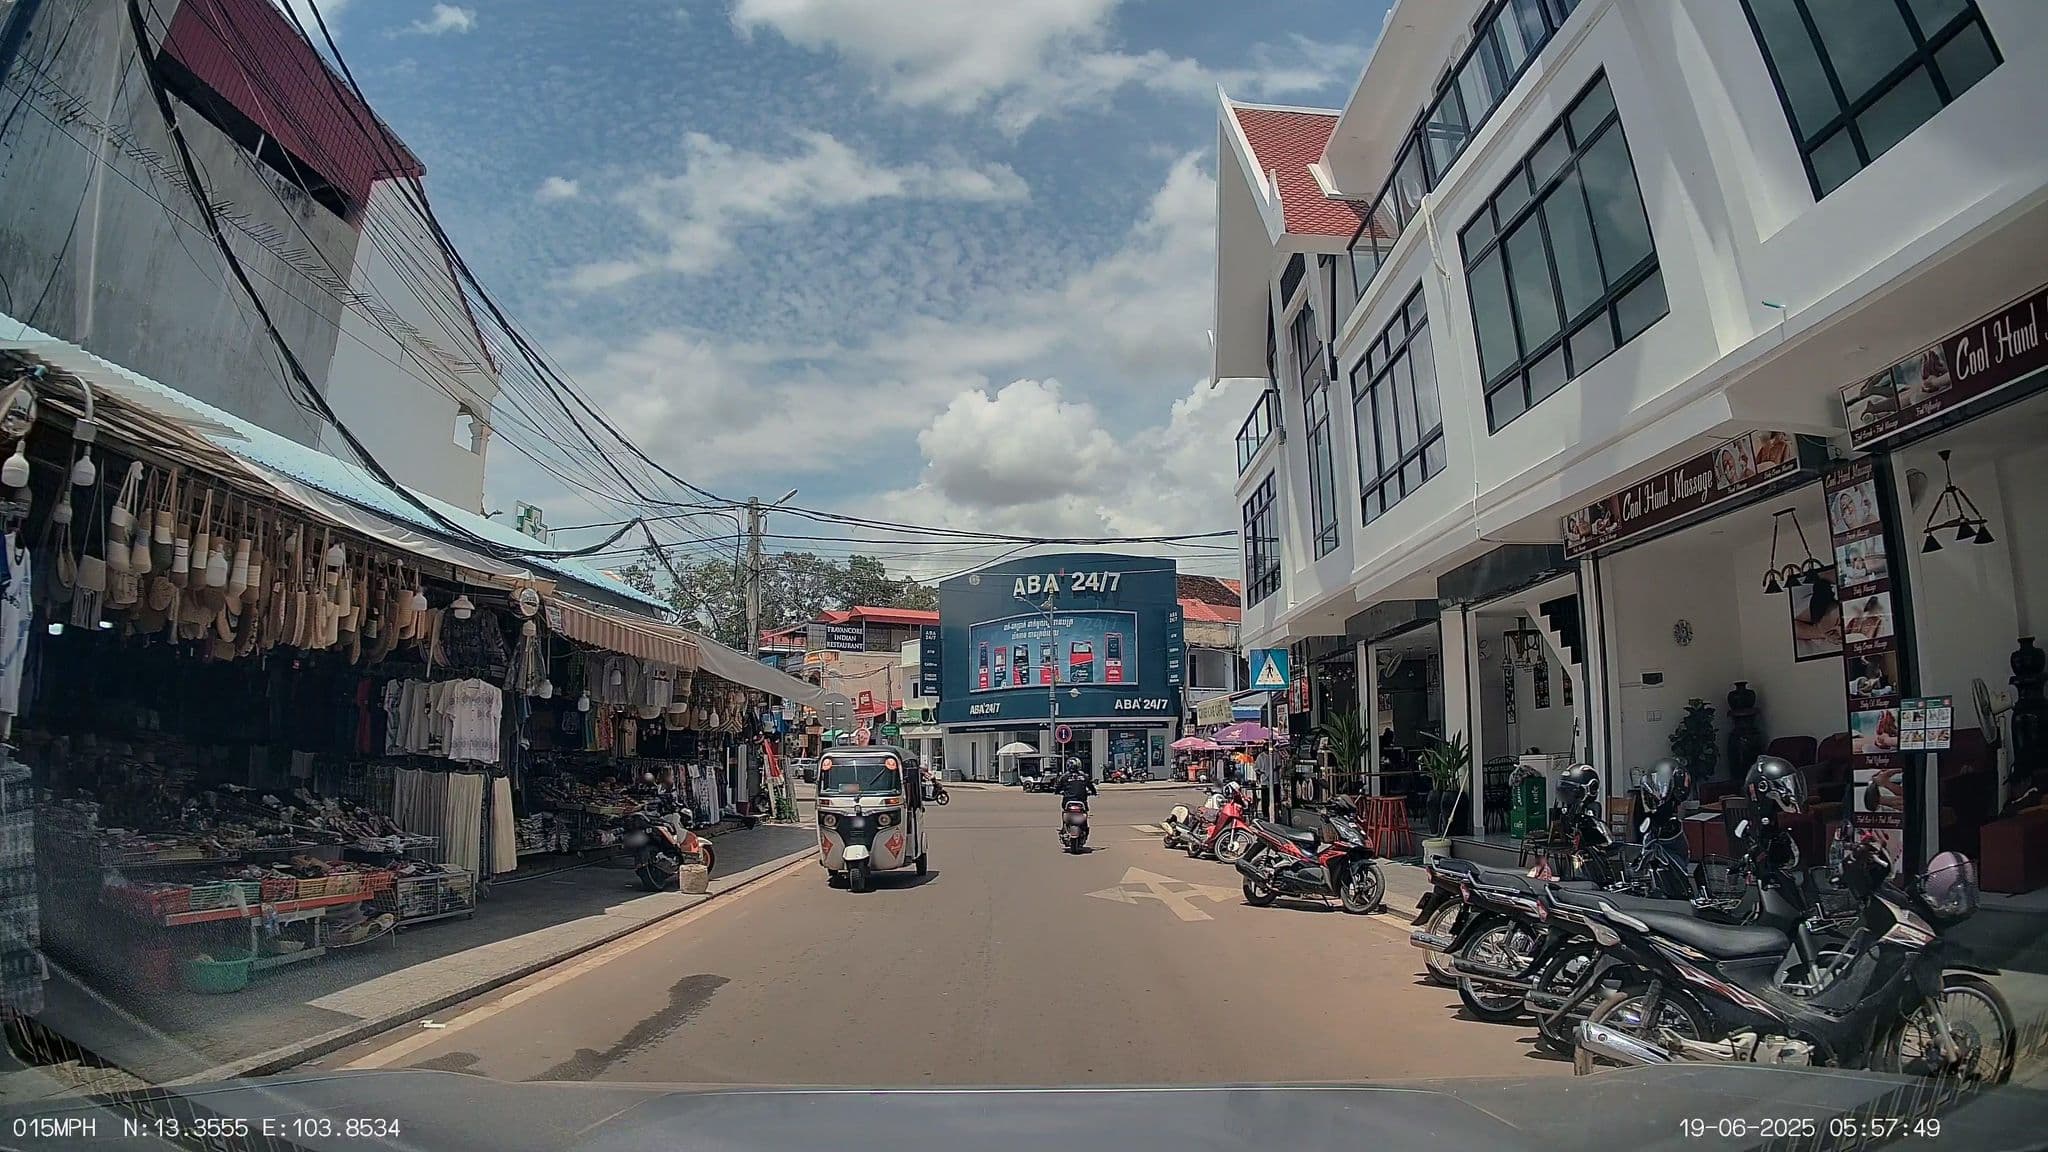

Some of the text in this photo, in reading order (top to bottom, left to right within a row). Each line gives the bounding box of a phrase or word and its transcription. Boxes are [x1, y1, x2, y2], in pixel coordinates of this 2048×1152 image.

[1956, 326, 1989, 380] Cool
[1993, 302, 2038, 364] Hand
[1622, 468, 1713, 522] Cool Hand Massage
[1012, 571, 1121, 597] ABA 24/7
[827, 626, 863, 635] TRAVANCORE
[826, 641, 864, 650] RESTAURANT
[970, 702, 1001, 715] ABA 24/7
[1114, 698, 1169, 710] ABA 24/7
